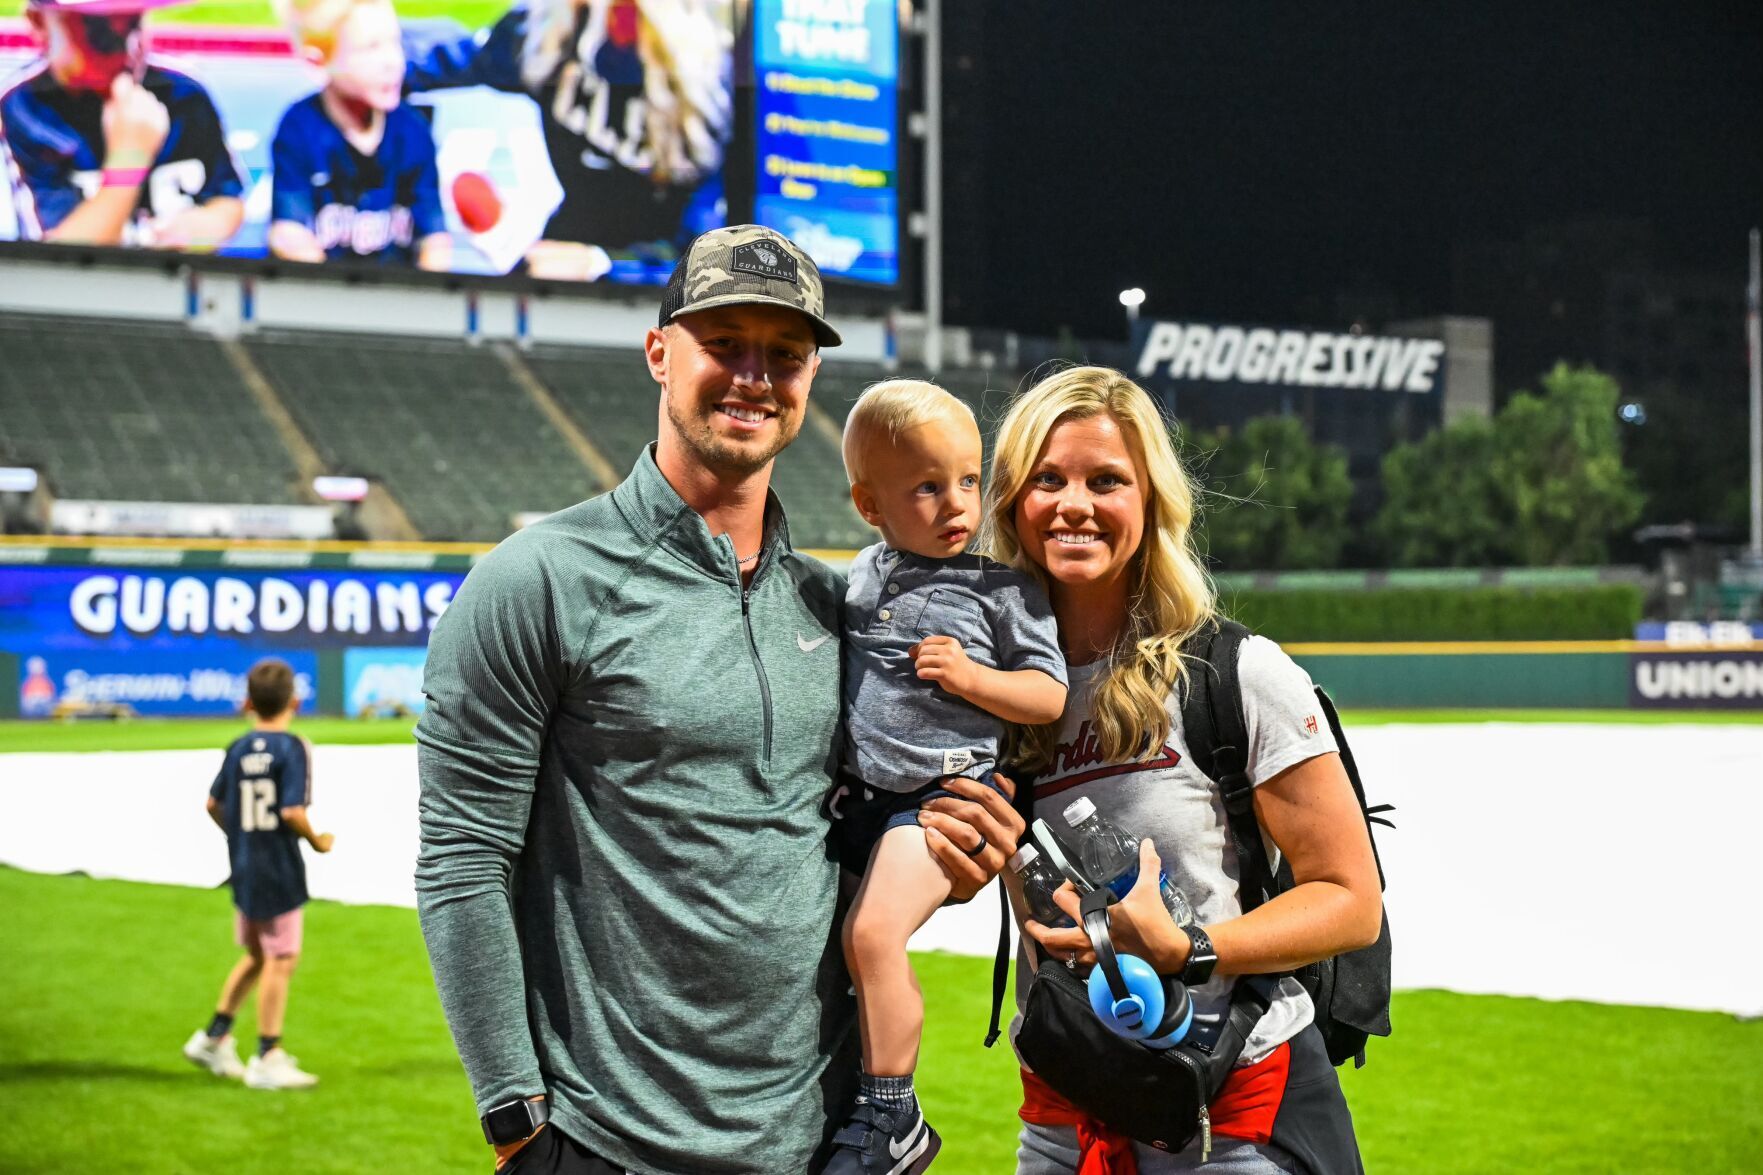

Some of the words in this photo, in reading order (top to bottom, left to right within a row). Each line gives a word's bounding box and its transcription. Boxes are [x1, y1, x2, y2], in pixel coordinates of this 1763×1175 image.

[739, 243, 792, 263] CLEVELAND
[739, 262, 793, 278] GUARDIANS
[1137, 321, 1444, 393] PROGRESSIVE
[70, 575, 453, 633] GUARDIANS
[240, 778, 279, 832] 12
